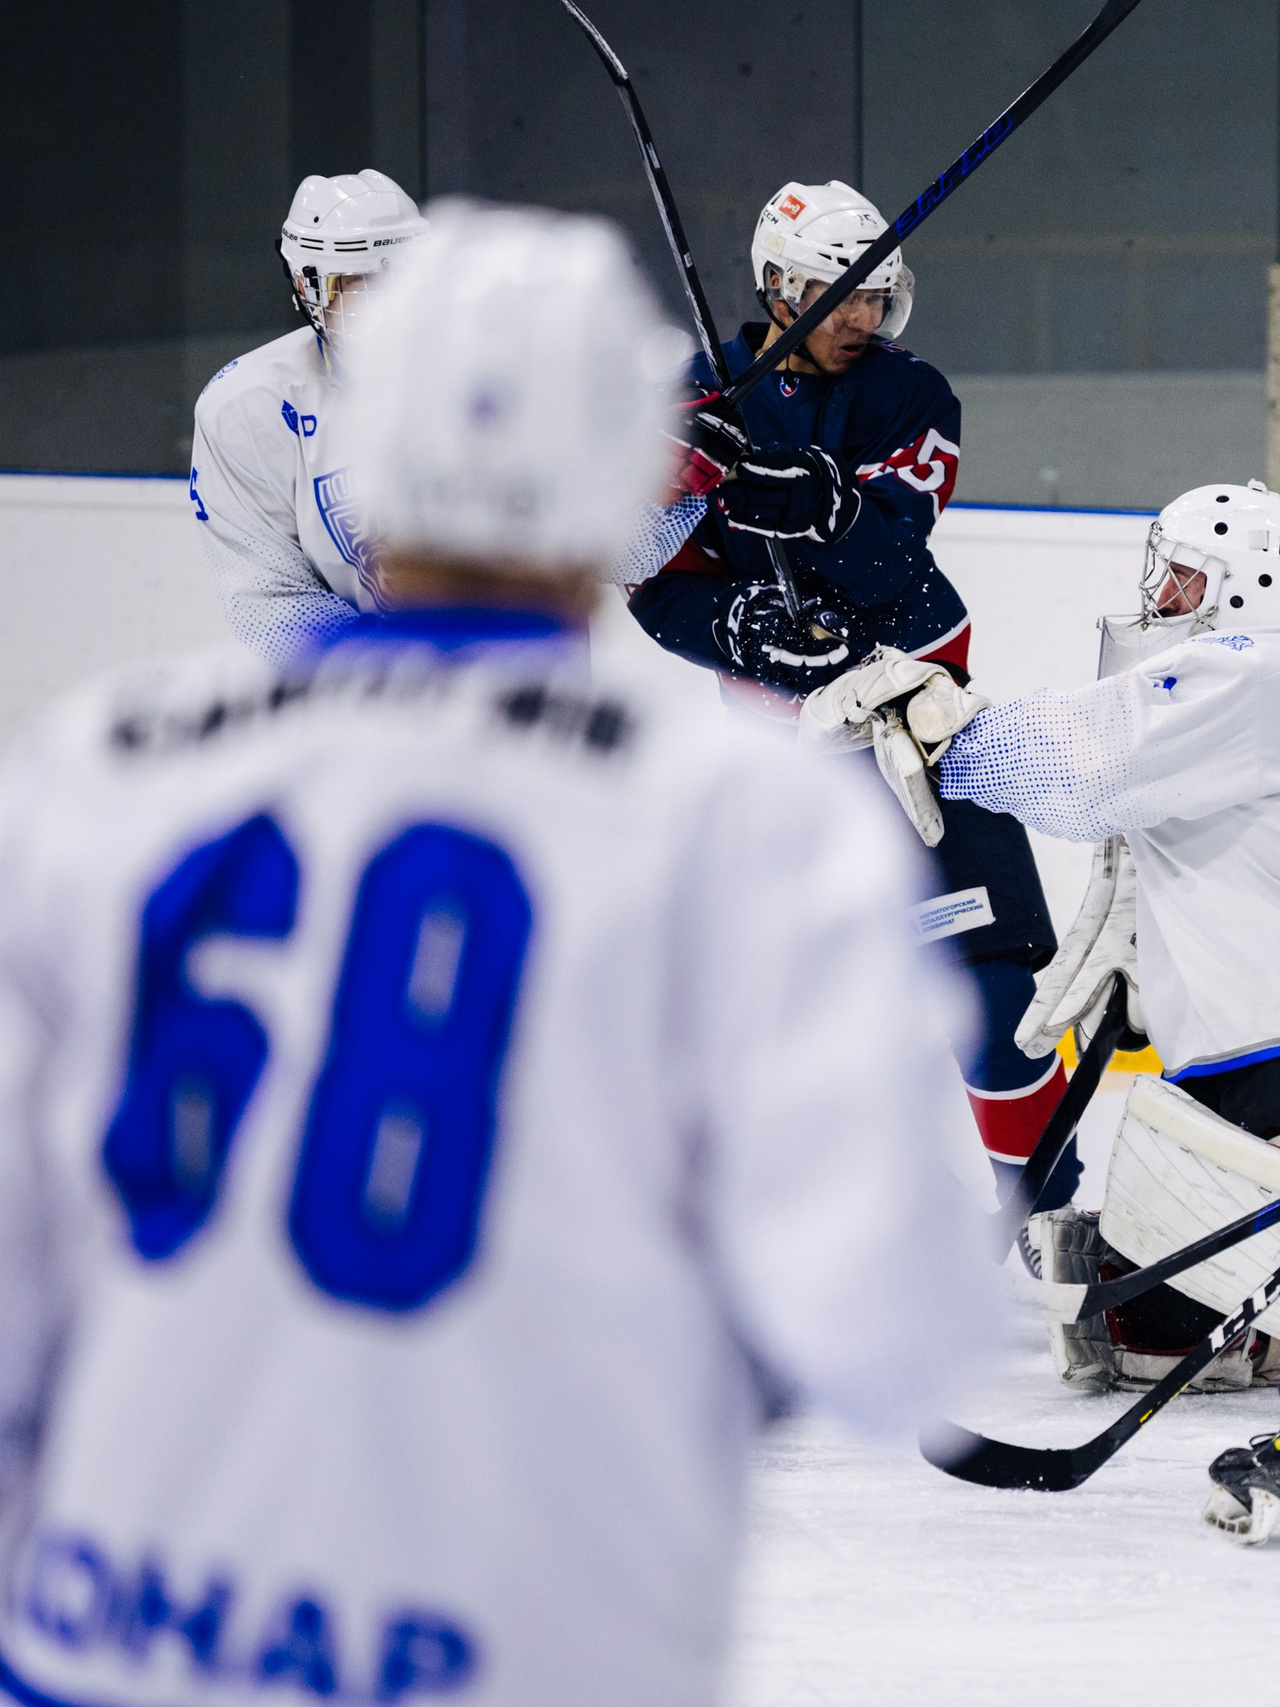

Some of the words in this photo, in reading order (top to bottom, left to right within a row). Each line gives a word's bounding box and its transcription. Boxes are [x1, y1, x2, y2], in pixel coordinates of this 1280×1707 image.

[762, 209, 779, 225] CCM
[373, 236, 413, 247] BAUER
[102, 808, 532, 1313] 68
